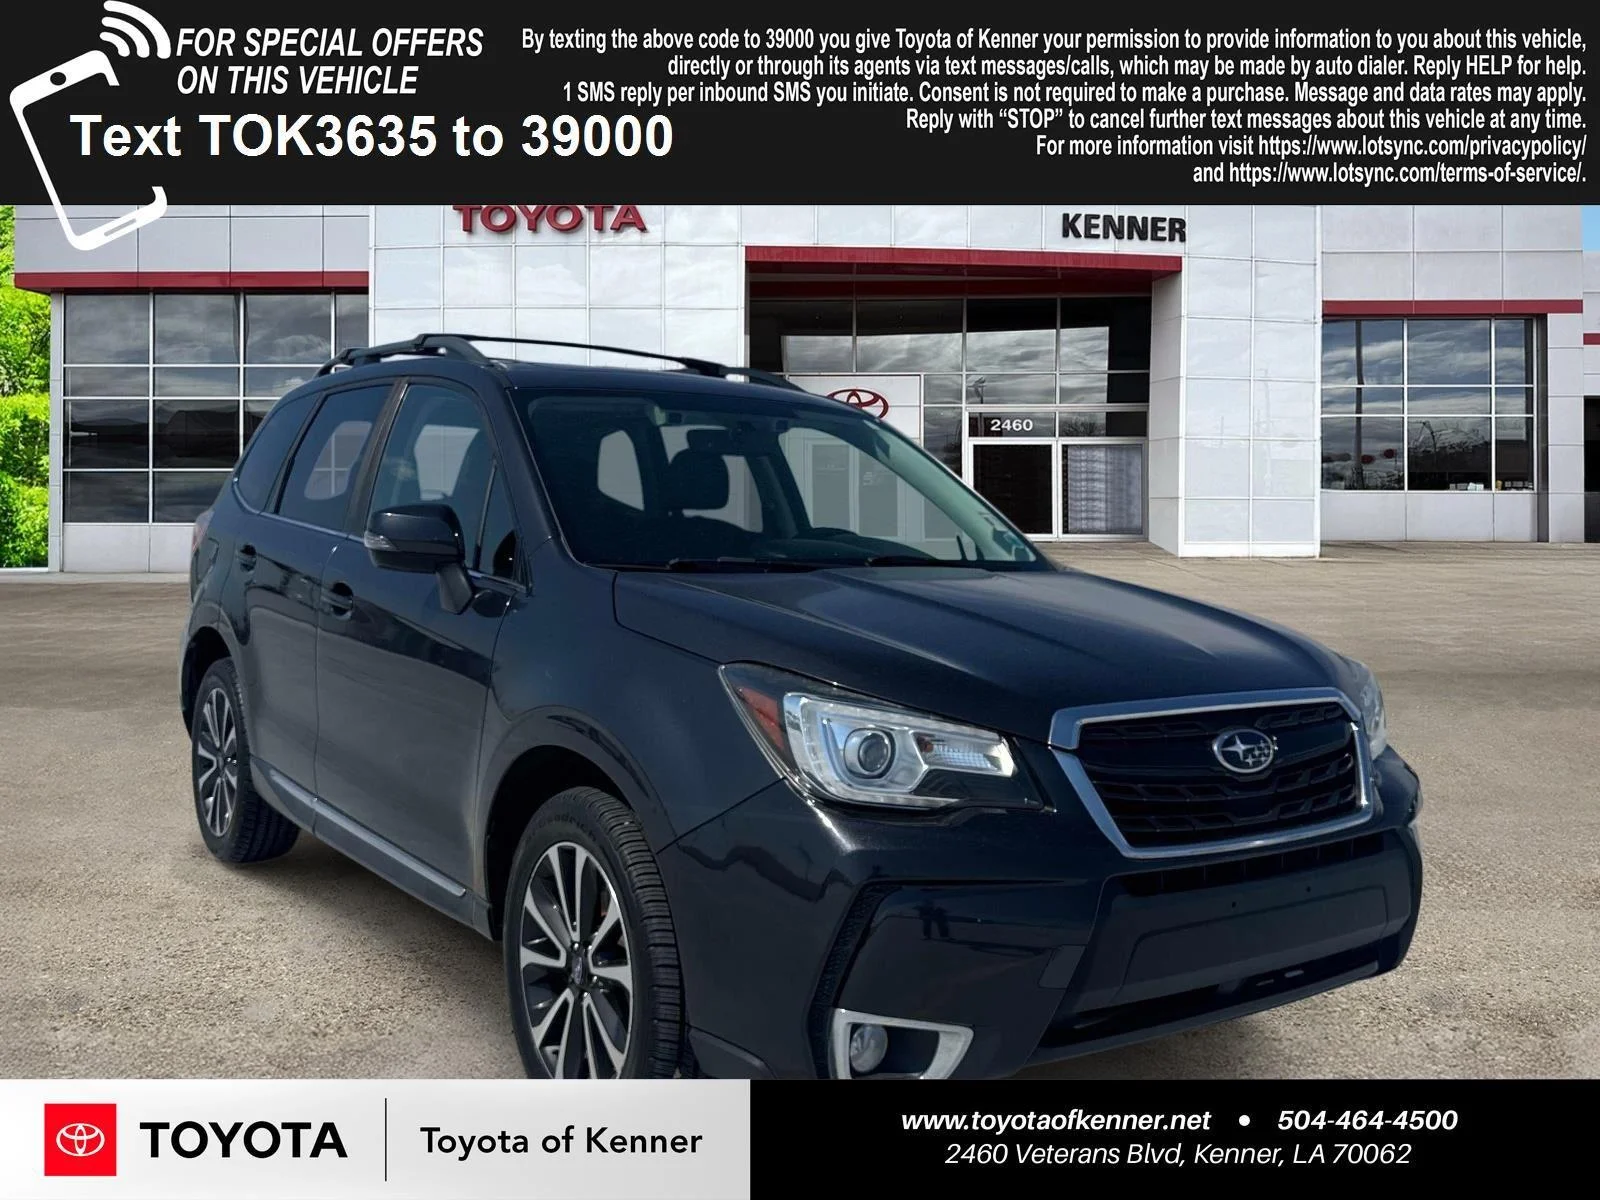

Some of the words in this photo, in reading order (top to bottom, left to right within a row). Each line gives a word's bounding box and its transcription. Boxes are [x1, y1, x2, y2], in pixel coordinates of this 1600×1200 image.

[453, 205, 648, 233] TOYOTA
[1061, 213, 1187, 243] KENNER
[991, 419, 1033, 431] 2460
